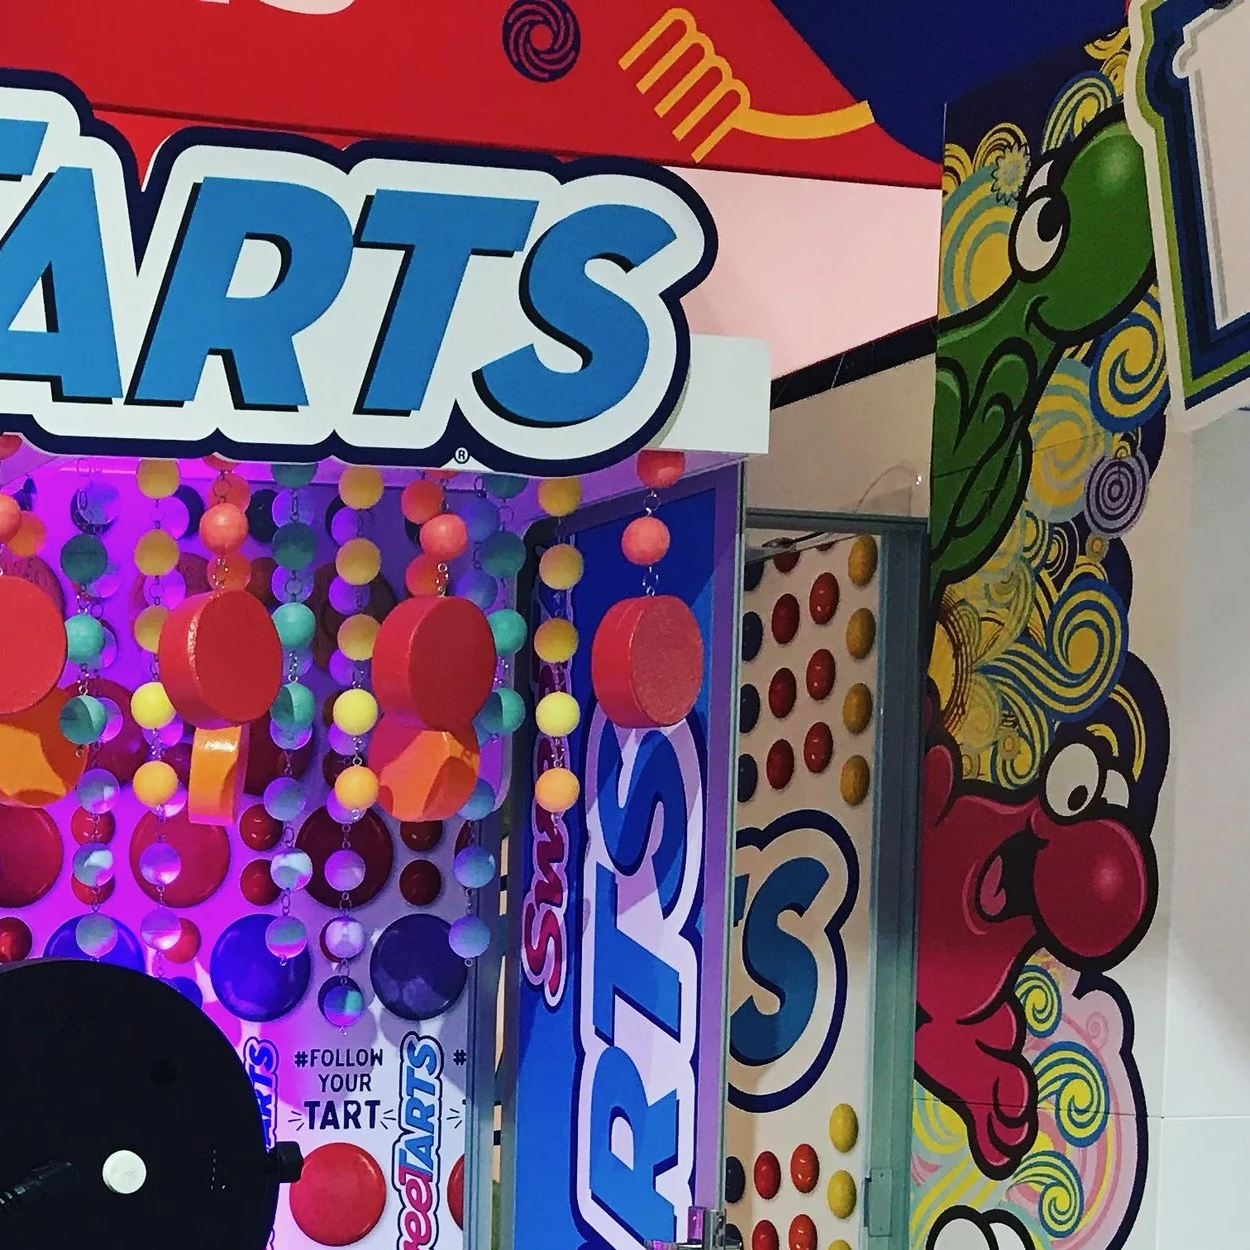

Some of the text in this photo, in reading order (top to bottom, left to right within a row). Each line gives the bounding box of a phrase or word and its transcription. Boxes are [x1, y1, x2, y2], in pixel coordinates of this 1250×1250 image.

[294, 1048, 383, 1069] #FOLLOW
[318, 1073, 372, 1092] YOUR
[304, 1099, 381, 1131] TART
